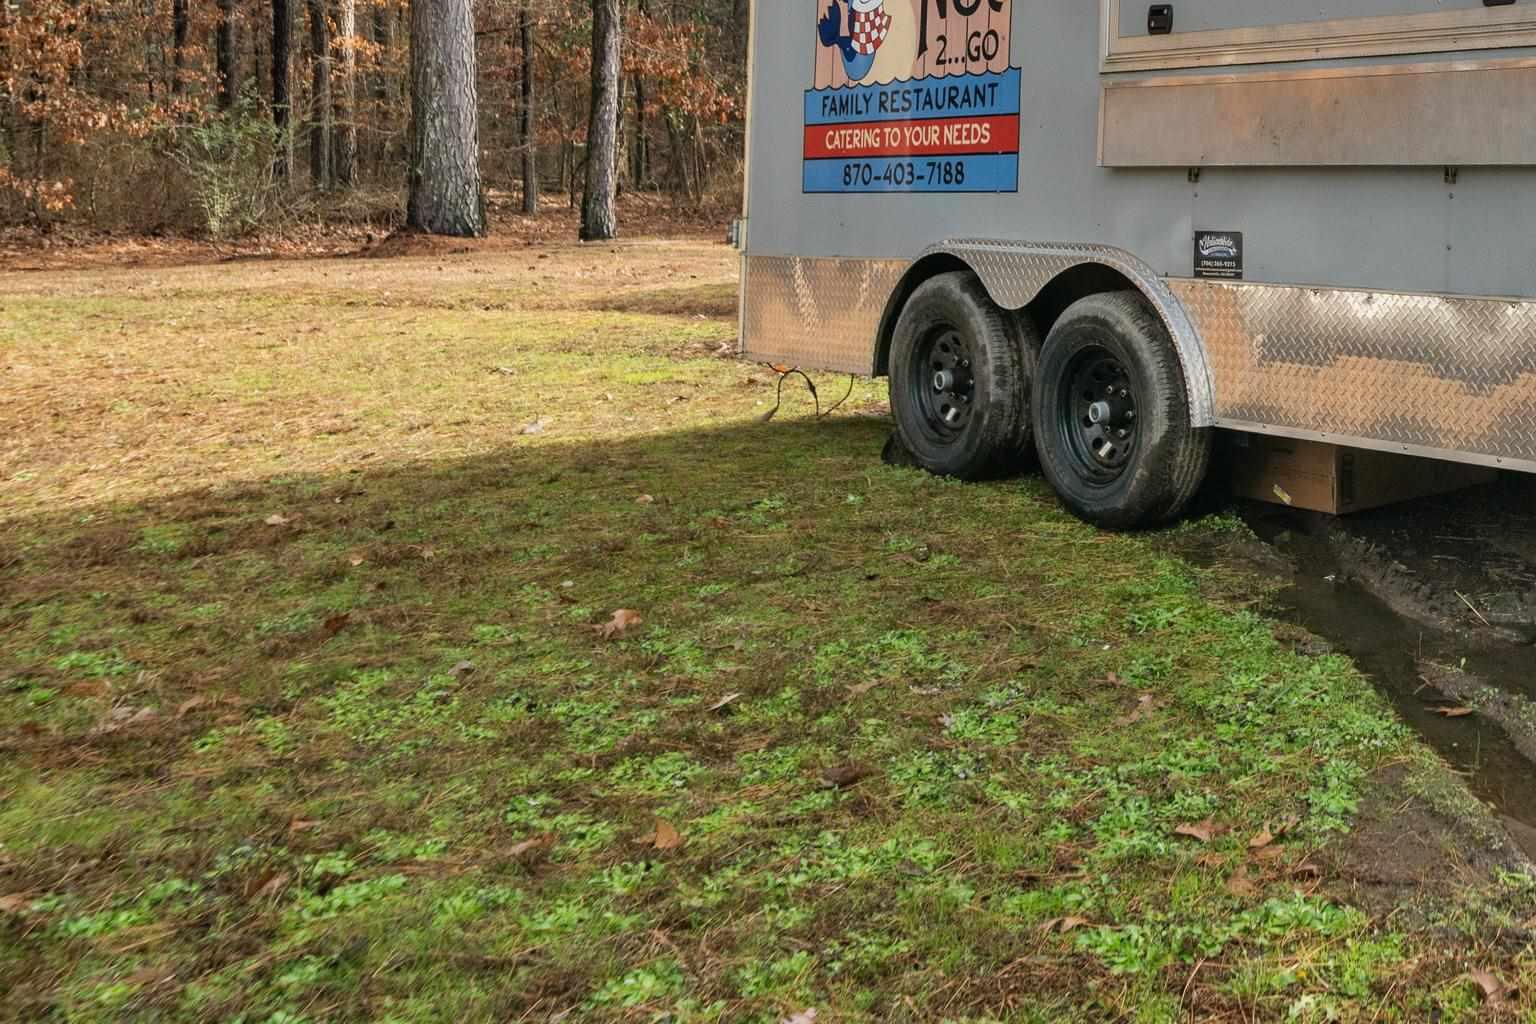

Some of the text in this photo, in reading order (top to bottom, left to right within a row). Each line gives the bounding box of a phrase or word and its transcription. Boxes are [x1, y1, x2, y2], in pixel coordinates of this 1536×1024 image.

[822, 82, 999, 117] FAMILY RESTAURANT
[825, 123, 991, 149] CATERING TO YOUR NEEDS
[842, 161, 966, 186] 870-403-7188
